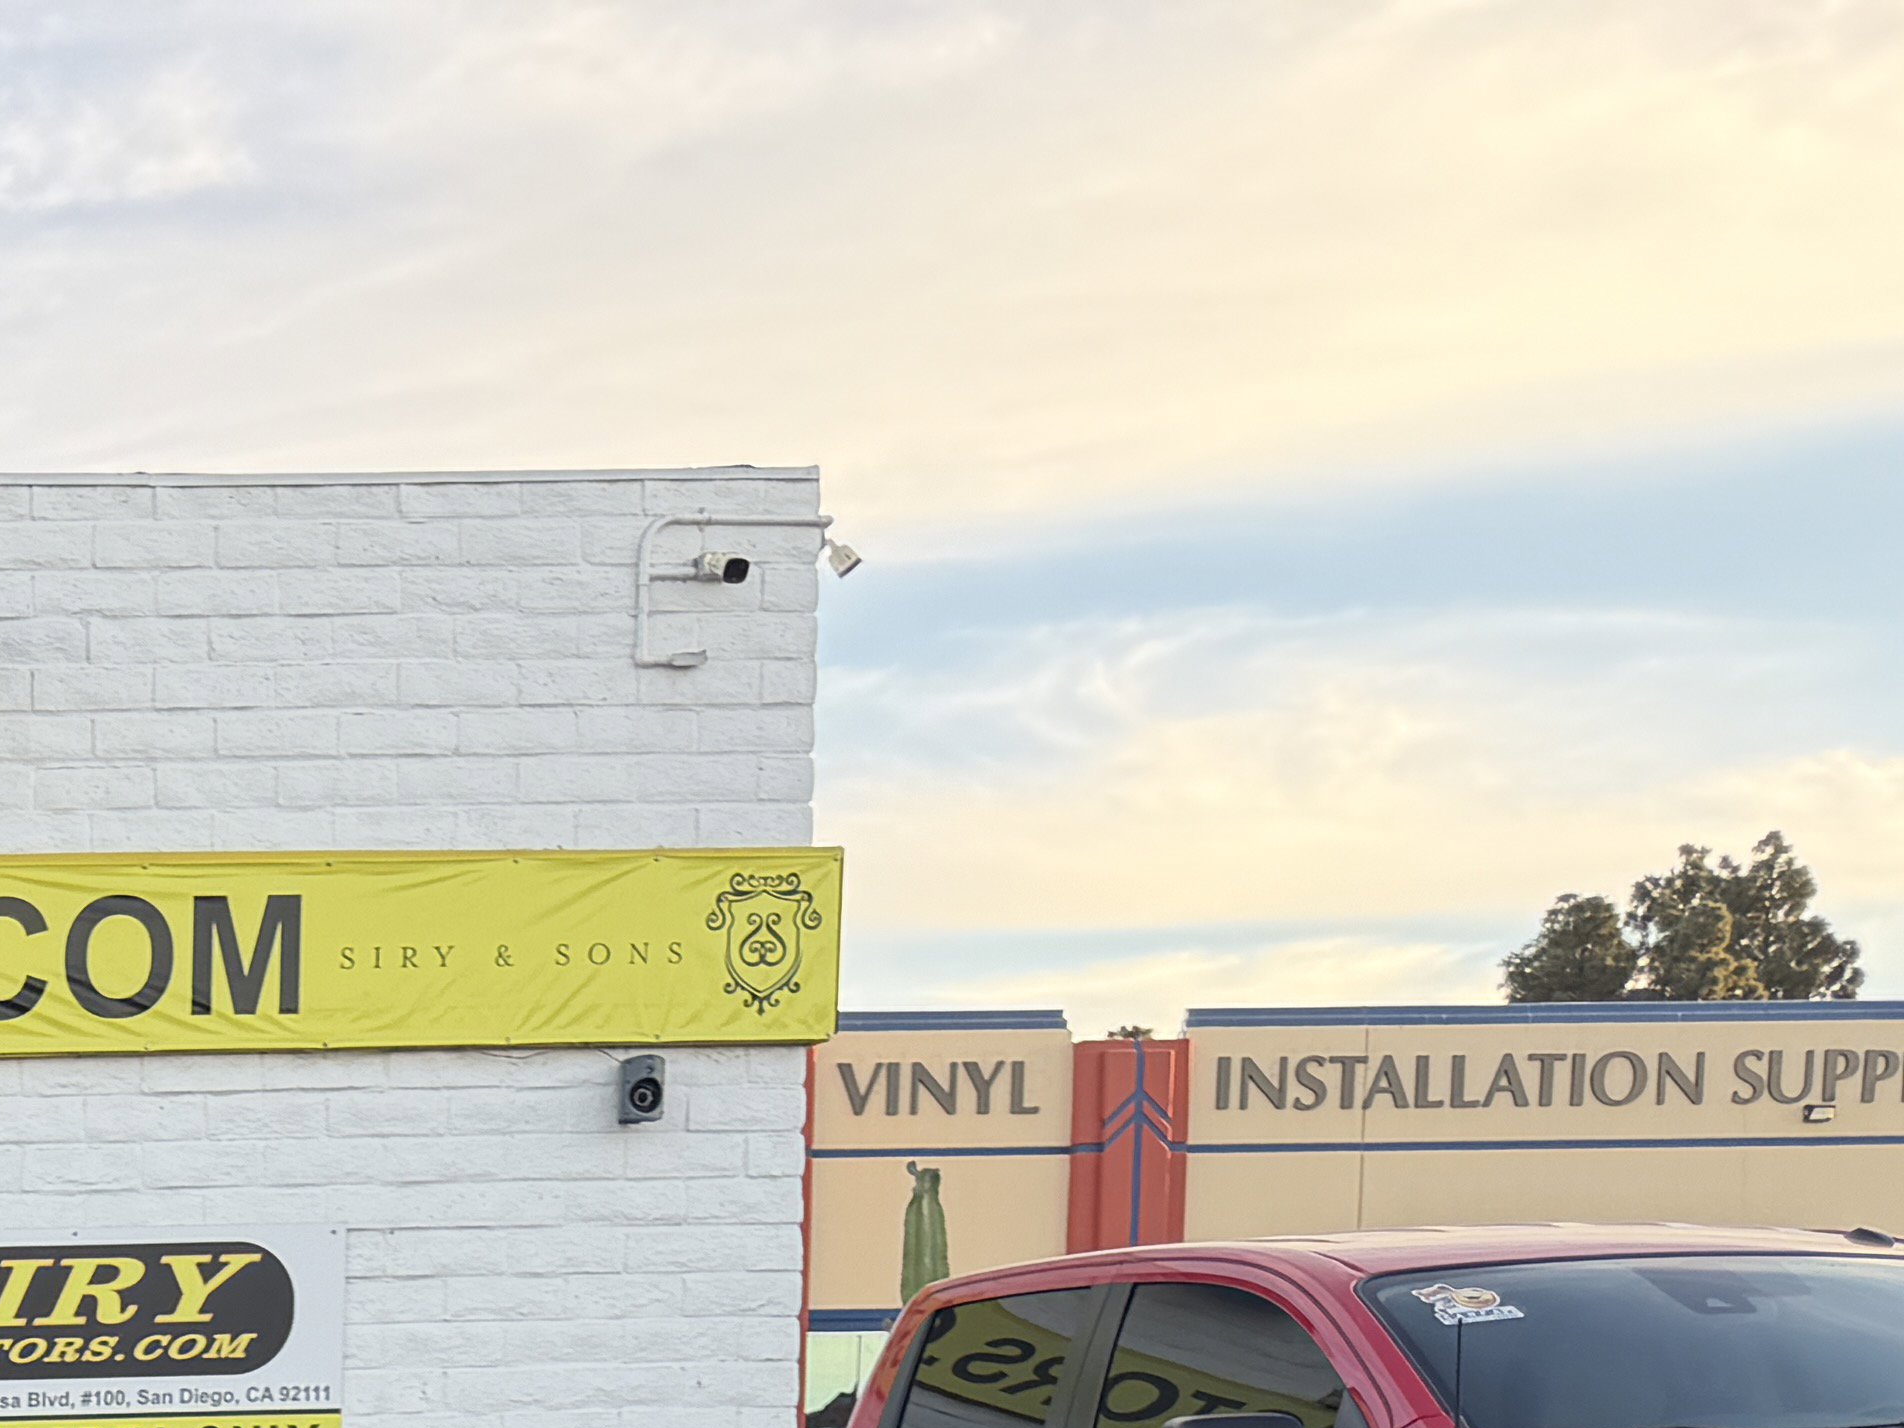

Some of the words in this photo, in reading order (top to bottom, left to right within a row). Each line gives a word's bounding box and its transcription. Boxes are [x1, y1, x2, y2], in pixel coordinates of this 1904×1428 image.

[339, 945, 455, 970] SIRY
[494, 943, 515, 967] &
[555, 941, 685, 966] SONS
[836, 1058, 1041, 1119] VINYL
[1214, 1047, 1708, 1112] INSTALLATION
[27, 1391, 77, 1411] Blvd,
[80, 1388, 132, 1408] #100,
[137, 1388, 175, 1406] San
[179, 1387, 241, 1408] Diego,
[246, 1386, 275, 1404] CA
[279, 1385, 332, 1403] 92111
